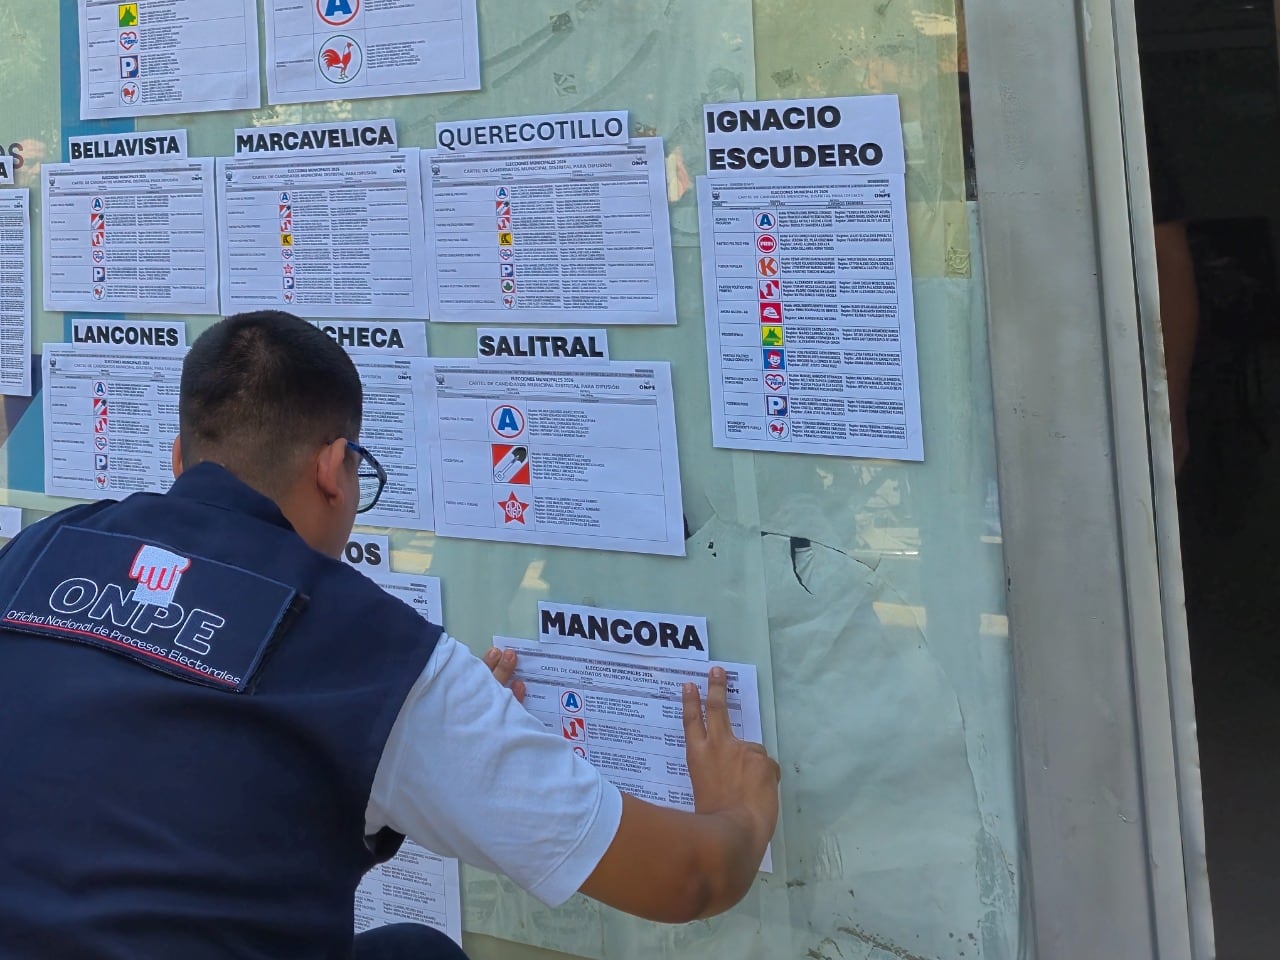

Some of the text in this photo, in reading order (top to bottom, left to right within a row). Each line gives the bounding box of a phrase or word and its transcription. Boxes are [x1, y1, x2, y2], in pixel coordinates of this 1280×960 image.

[707, 105, 842, 133] IGNACIO
[236, 125, 395, 153] MARCAVELICA
[438, 117, 624, 151] QUERECOTILLO
[70, 135, 181, 160] BELLAVISTA
[709, 142, 883, 171] ESCUDERO
[759, 213, 773, 228] A
[760, 258, 777, 277] K
[73, 325, 179, 346] LANCONES
[479, 335, 604, 358] SALITRAL
[498, 407, 520, 431] A
[48, 577, 226, 656] ONPE
[541, 609, 705, 651] MANCORA
[5, 609, 242, 686] Oficina Nacional de Procesos Electorales
[565, 693, 580, 710] A
